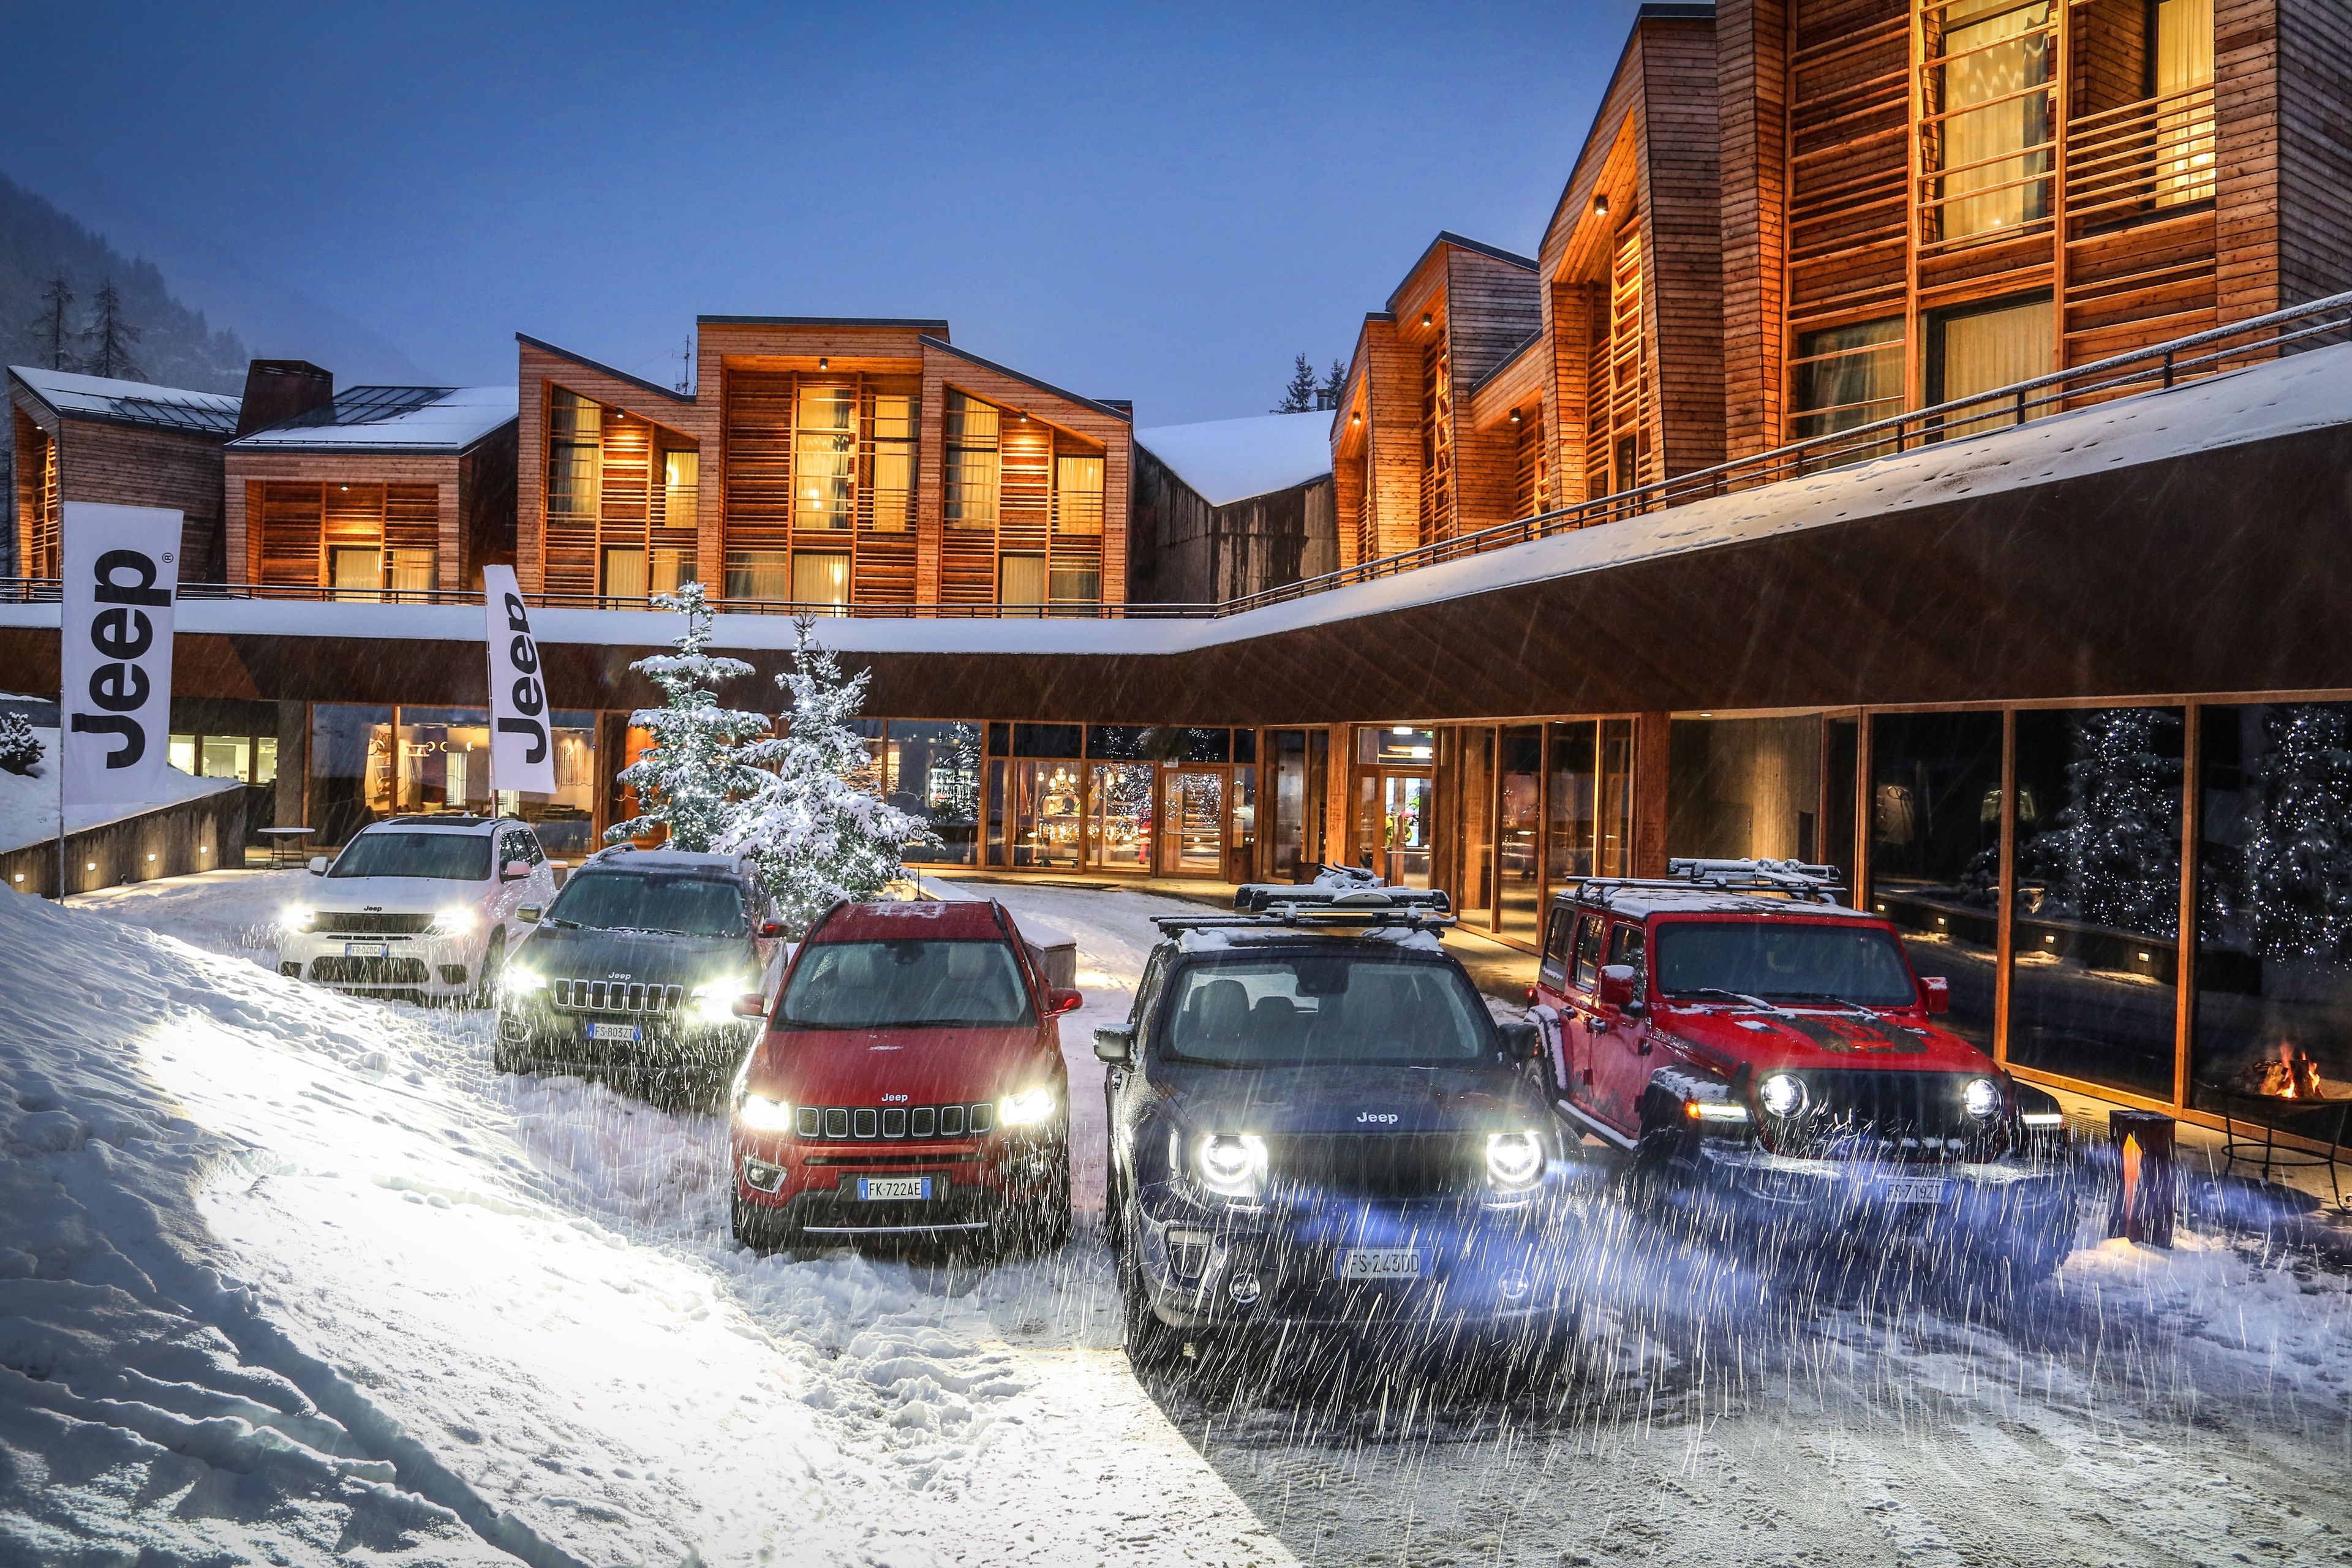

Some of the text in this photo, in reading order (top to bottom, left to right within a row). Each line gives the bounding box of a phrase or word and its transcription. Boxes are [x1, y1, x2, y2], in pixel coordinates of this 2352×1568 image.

[498, 592, 547, 764] Jeep
[608, 971, 631, 980] Jeep
[881, 1093, 908, 1102] Jeep
[1356, 1112, 1398, 1125] Jeep
